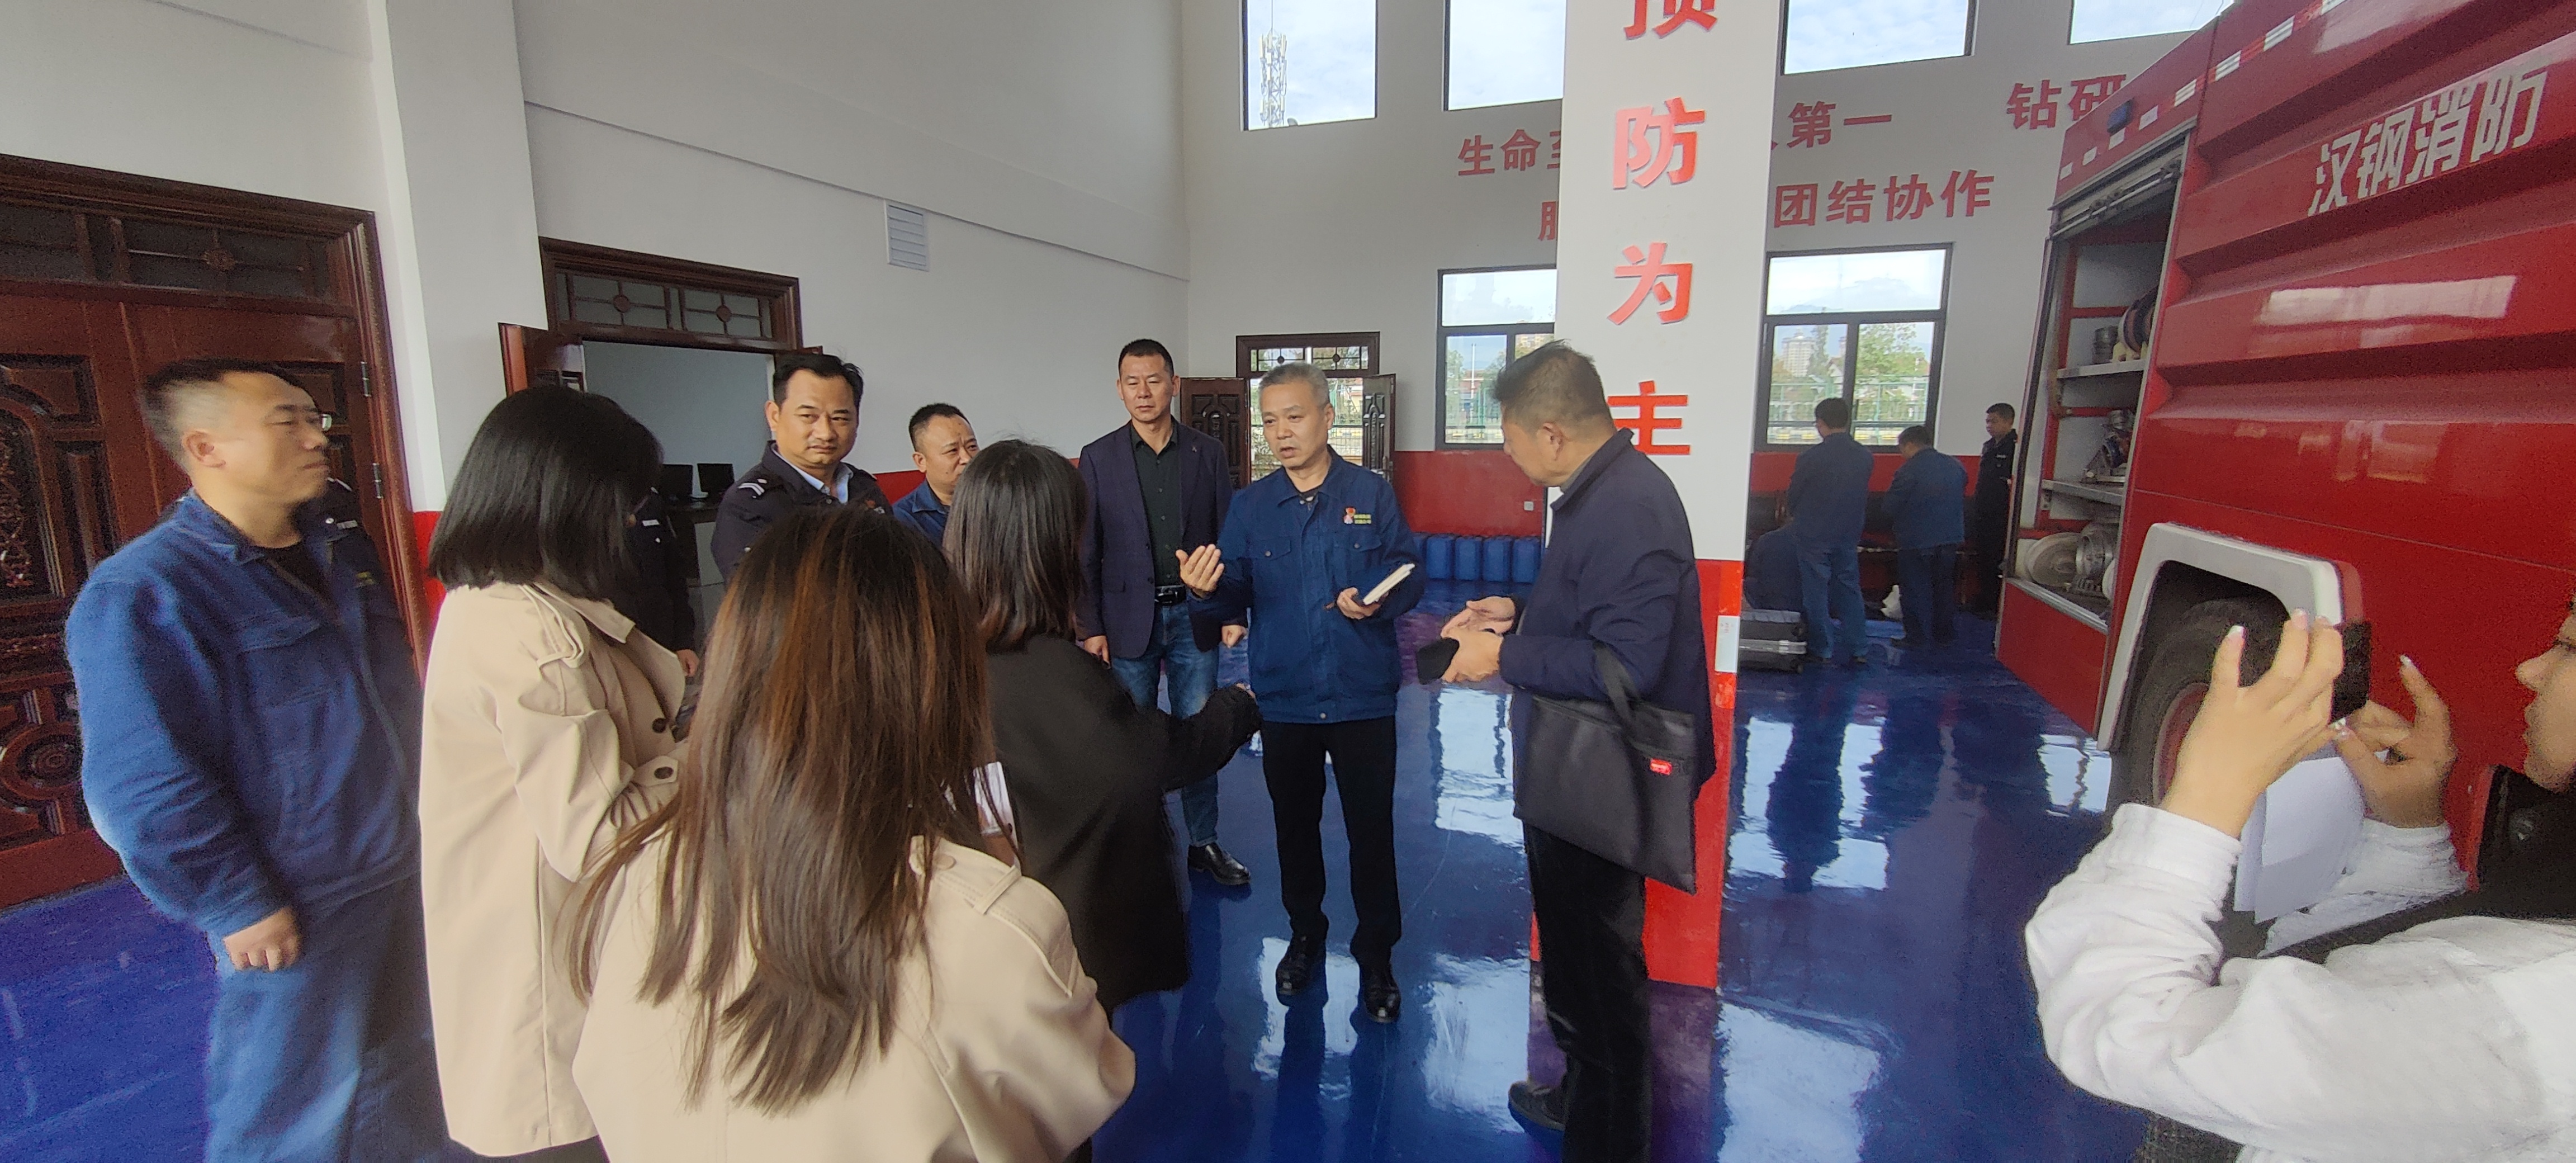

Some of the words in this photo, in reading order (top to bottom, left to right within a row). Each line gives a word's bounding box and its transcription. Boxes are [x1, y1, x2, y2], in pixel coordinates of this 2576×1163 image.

[1771, 101, 1892, 150] 第一
[2307, 70, 2548, 217] 汉钢消防
[1774, 169, 1995, 228] 团结协作
